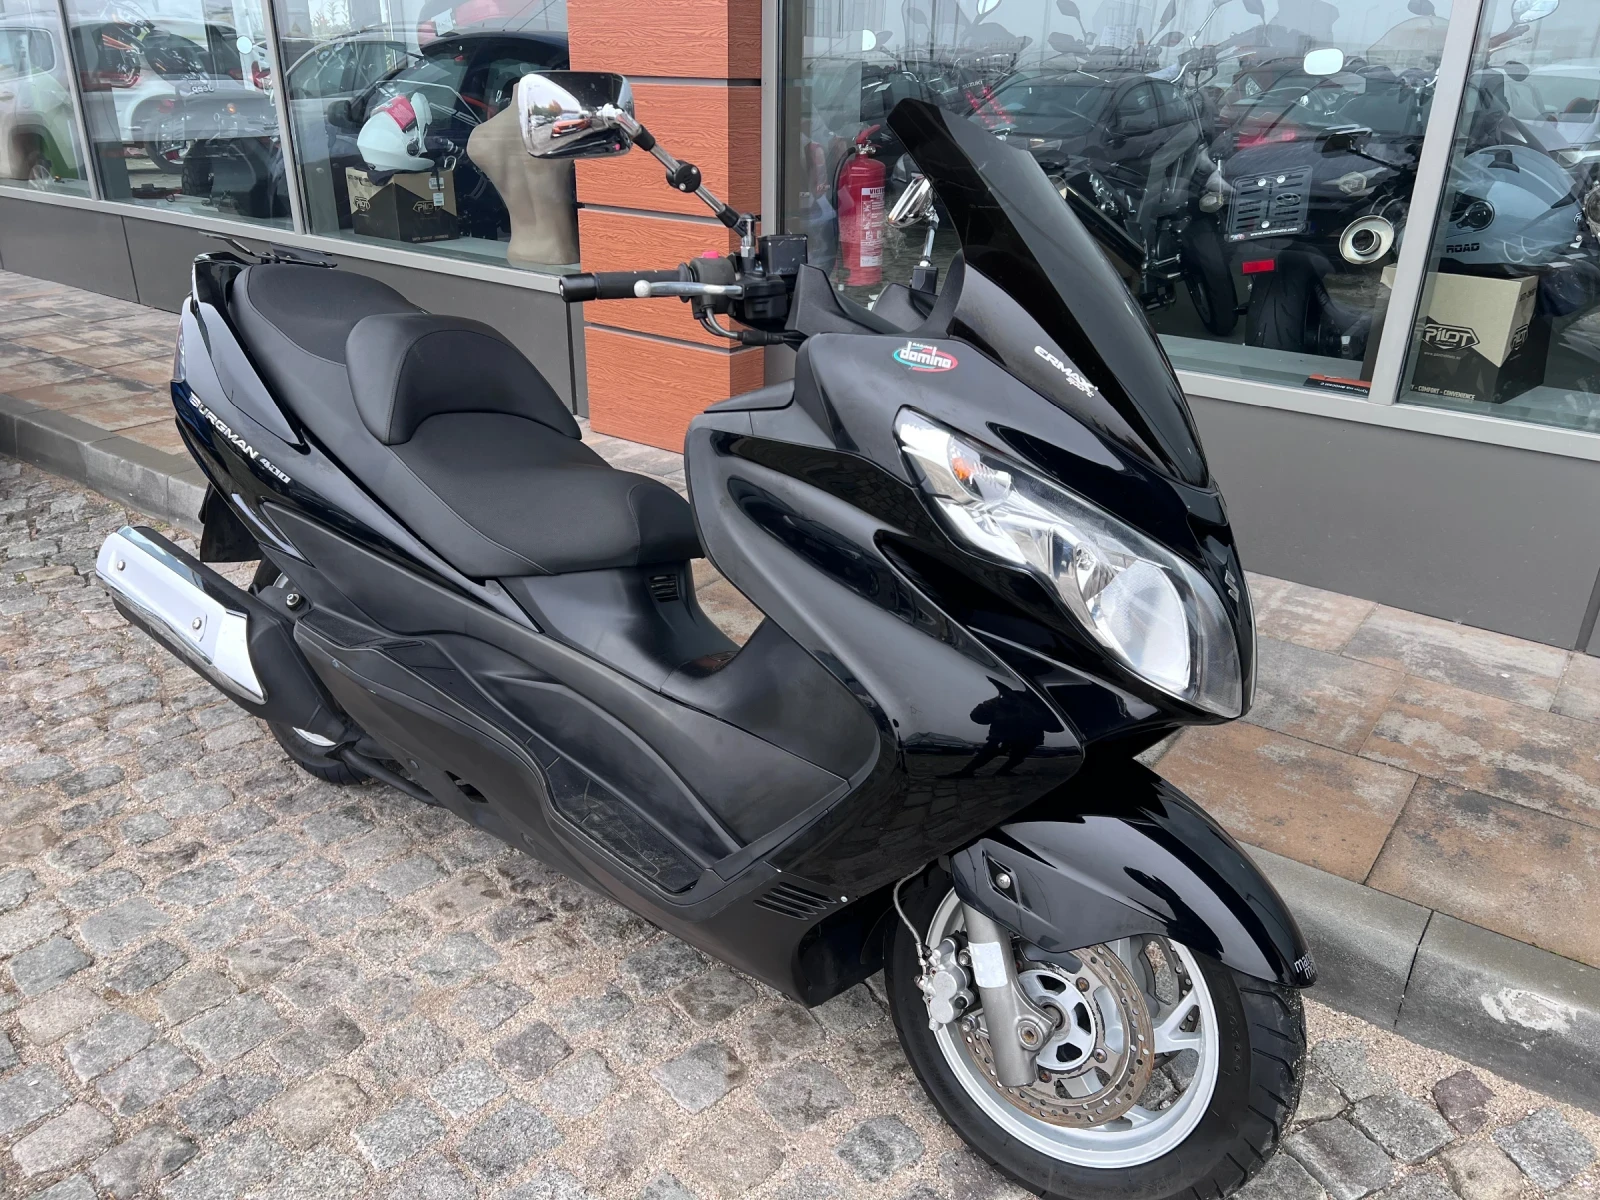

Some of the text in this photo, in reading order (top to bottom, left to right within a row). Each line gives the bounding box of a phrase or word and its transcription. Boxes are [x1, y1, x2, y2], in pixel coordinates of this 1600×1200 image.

[962, 80, 983, 89] SUZUKI
[1446, 242, 1480, 254] ROAD
[899, 341, 952, 369] domino
[1417, 385, 1440, 395] COMFORT
[1443, 389, 1476, 400] CONVENIENCE
[188, 391, 291, 484] BURGMAN 400
